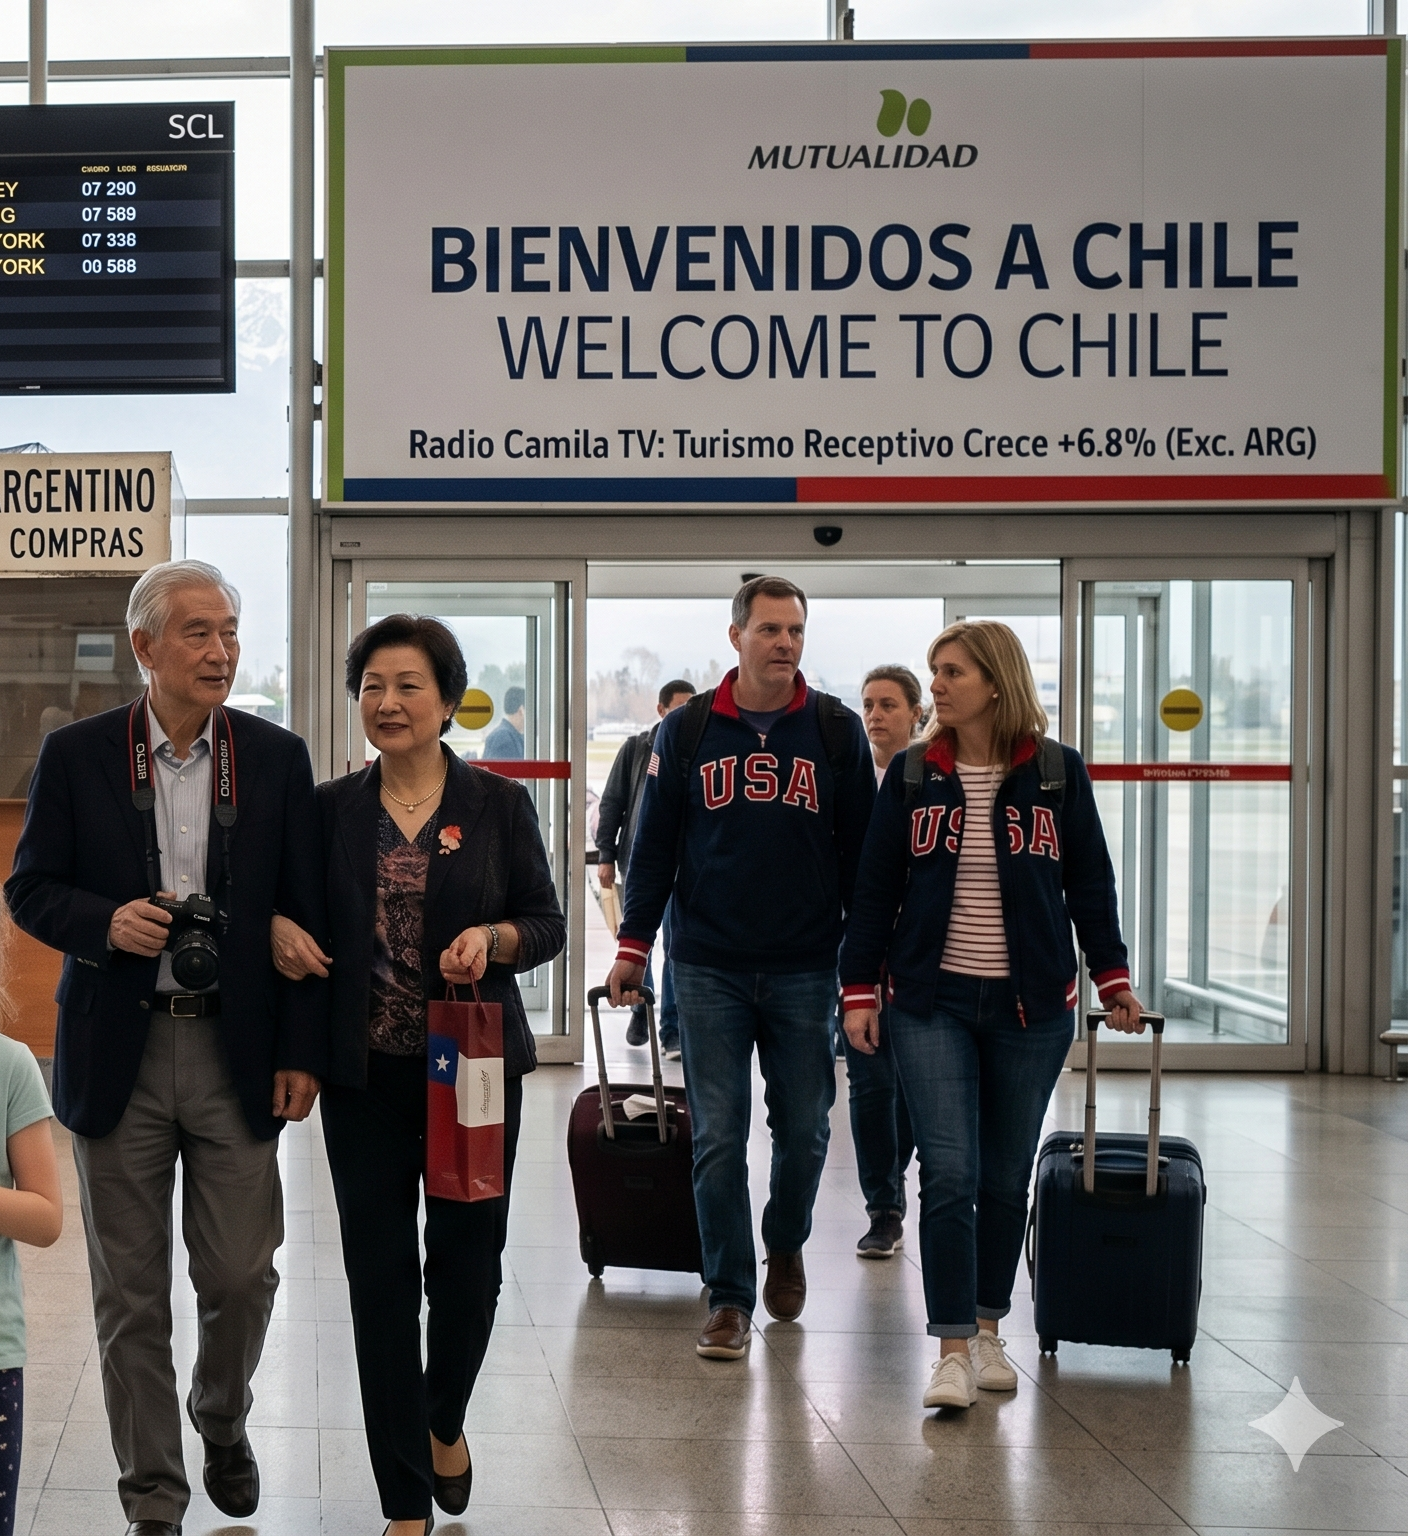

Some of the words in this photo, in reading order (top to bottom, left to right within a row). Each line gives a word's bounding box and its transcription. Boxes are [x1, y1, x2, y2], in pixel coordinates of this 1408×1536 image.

[168, 113, 224, 140] SCL
[747, 143, 979, 170] MUTUALIDAD
[81, 181, 102, 197] 07
[106, 181, 137, 197] 290
[81, 207, 102, 222] 07
[106, 206, 137, 222] 589
[81, 232, 102, 248] 07
[430, 222, 973, 295] BIENVENIDOS
[994, 223, 1050, 290] A
[1072, 220, 1300, 291] CHILE
[496, 314, 877, 381] WELCOME
[898, 312, 994, 380] TO
[1017, 311, 1229, 379] CHILE
[409, 428, 495, 459] Radio
[504, 428, 609, 459] Camila
[617, 429, 664, 459] TV:
[672, 428, 795, 459] Turismo
[804, 427, 954, 466] Receptivo
[963, 427, 1049, 458] Crece
[1057, 427, 1156, 458] +6.8%
[1165, 426, 1236, 461] (Exc.
[1243, 425, 1317, 461] ARG)
[10, 526, 144, 559] COMPRAS
[700, 753, 819, 813] USA
